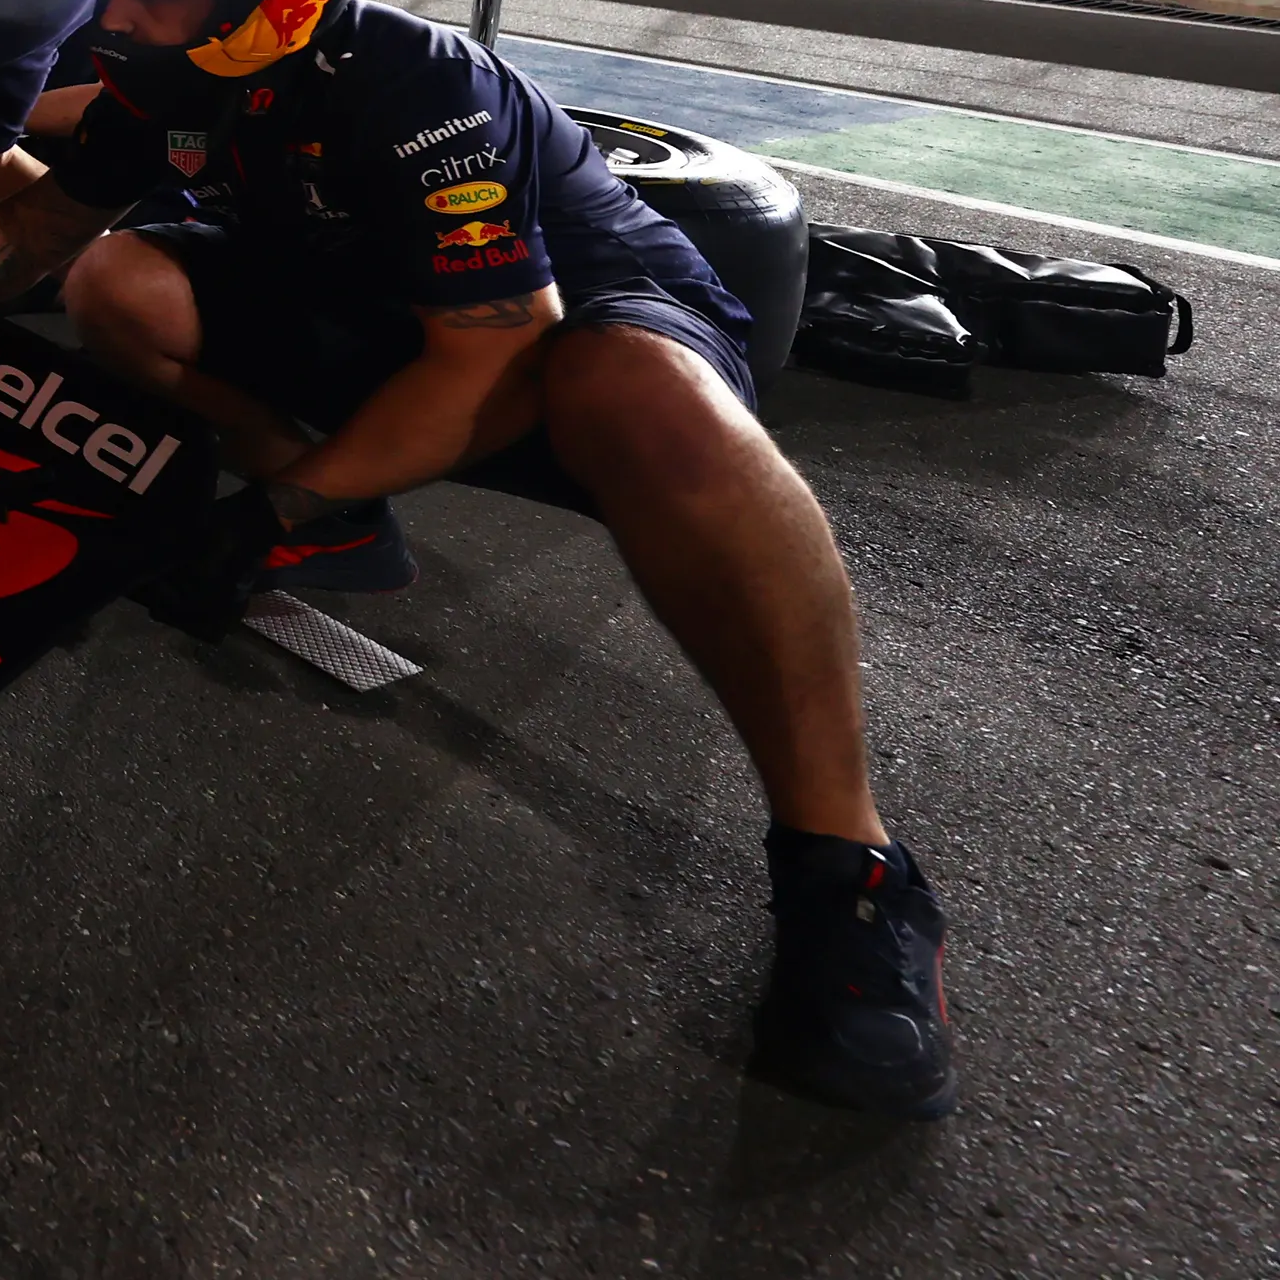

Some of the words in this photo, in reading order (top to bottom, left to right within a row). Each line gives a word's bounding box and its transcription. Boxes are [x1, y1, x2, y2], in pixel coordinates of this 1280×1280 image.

[172, 132, 207, 150] TAG
[393, 109, 493, 159] infinitum
[170, 151, 207, 170] HEUE
[420, 142, 507, 187] citrix
[448, 187, 500, 207] RAUCH
[431, 249, 484, 274] Red
[484, 239, 530, 267] Bull
